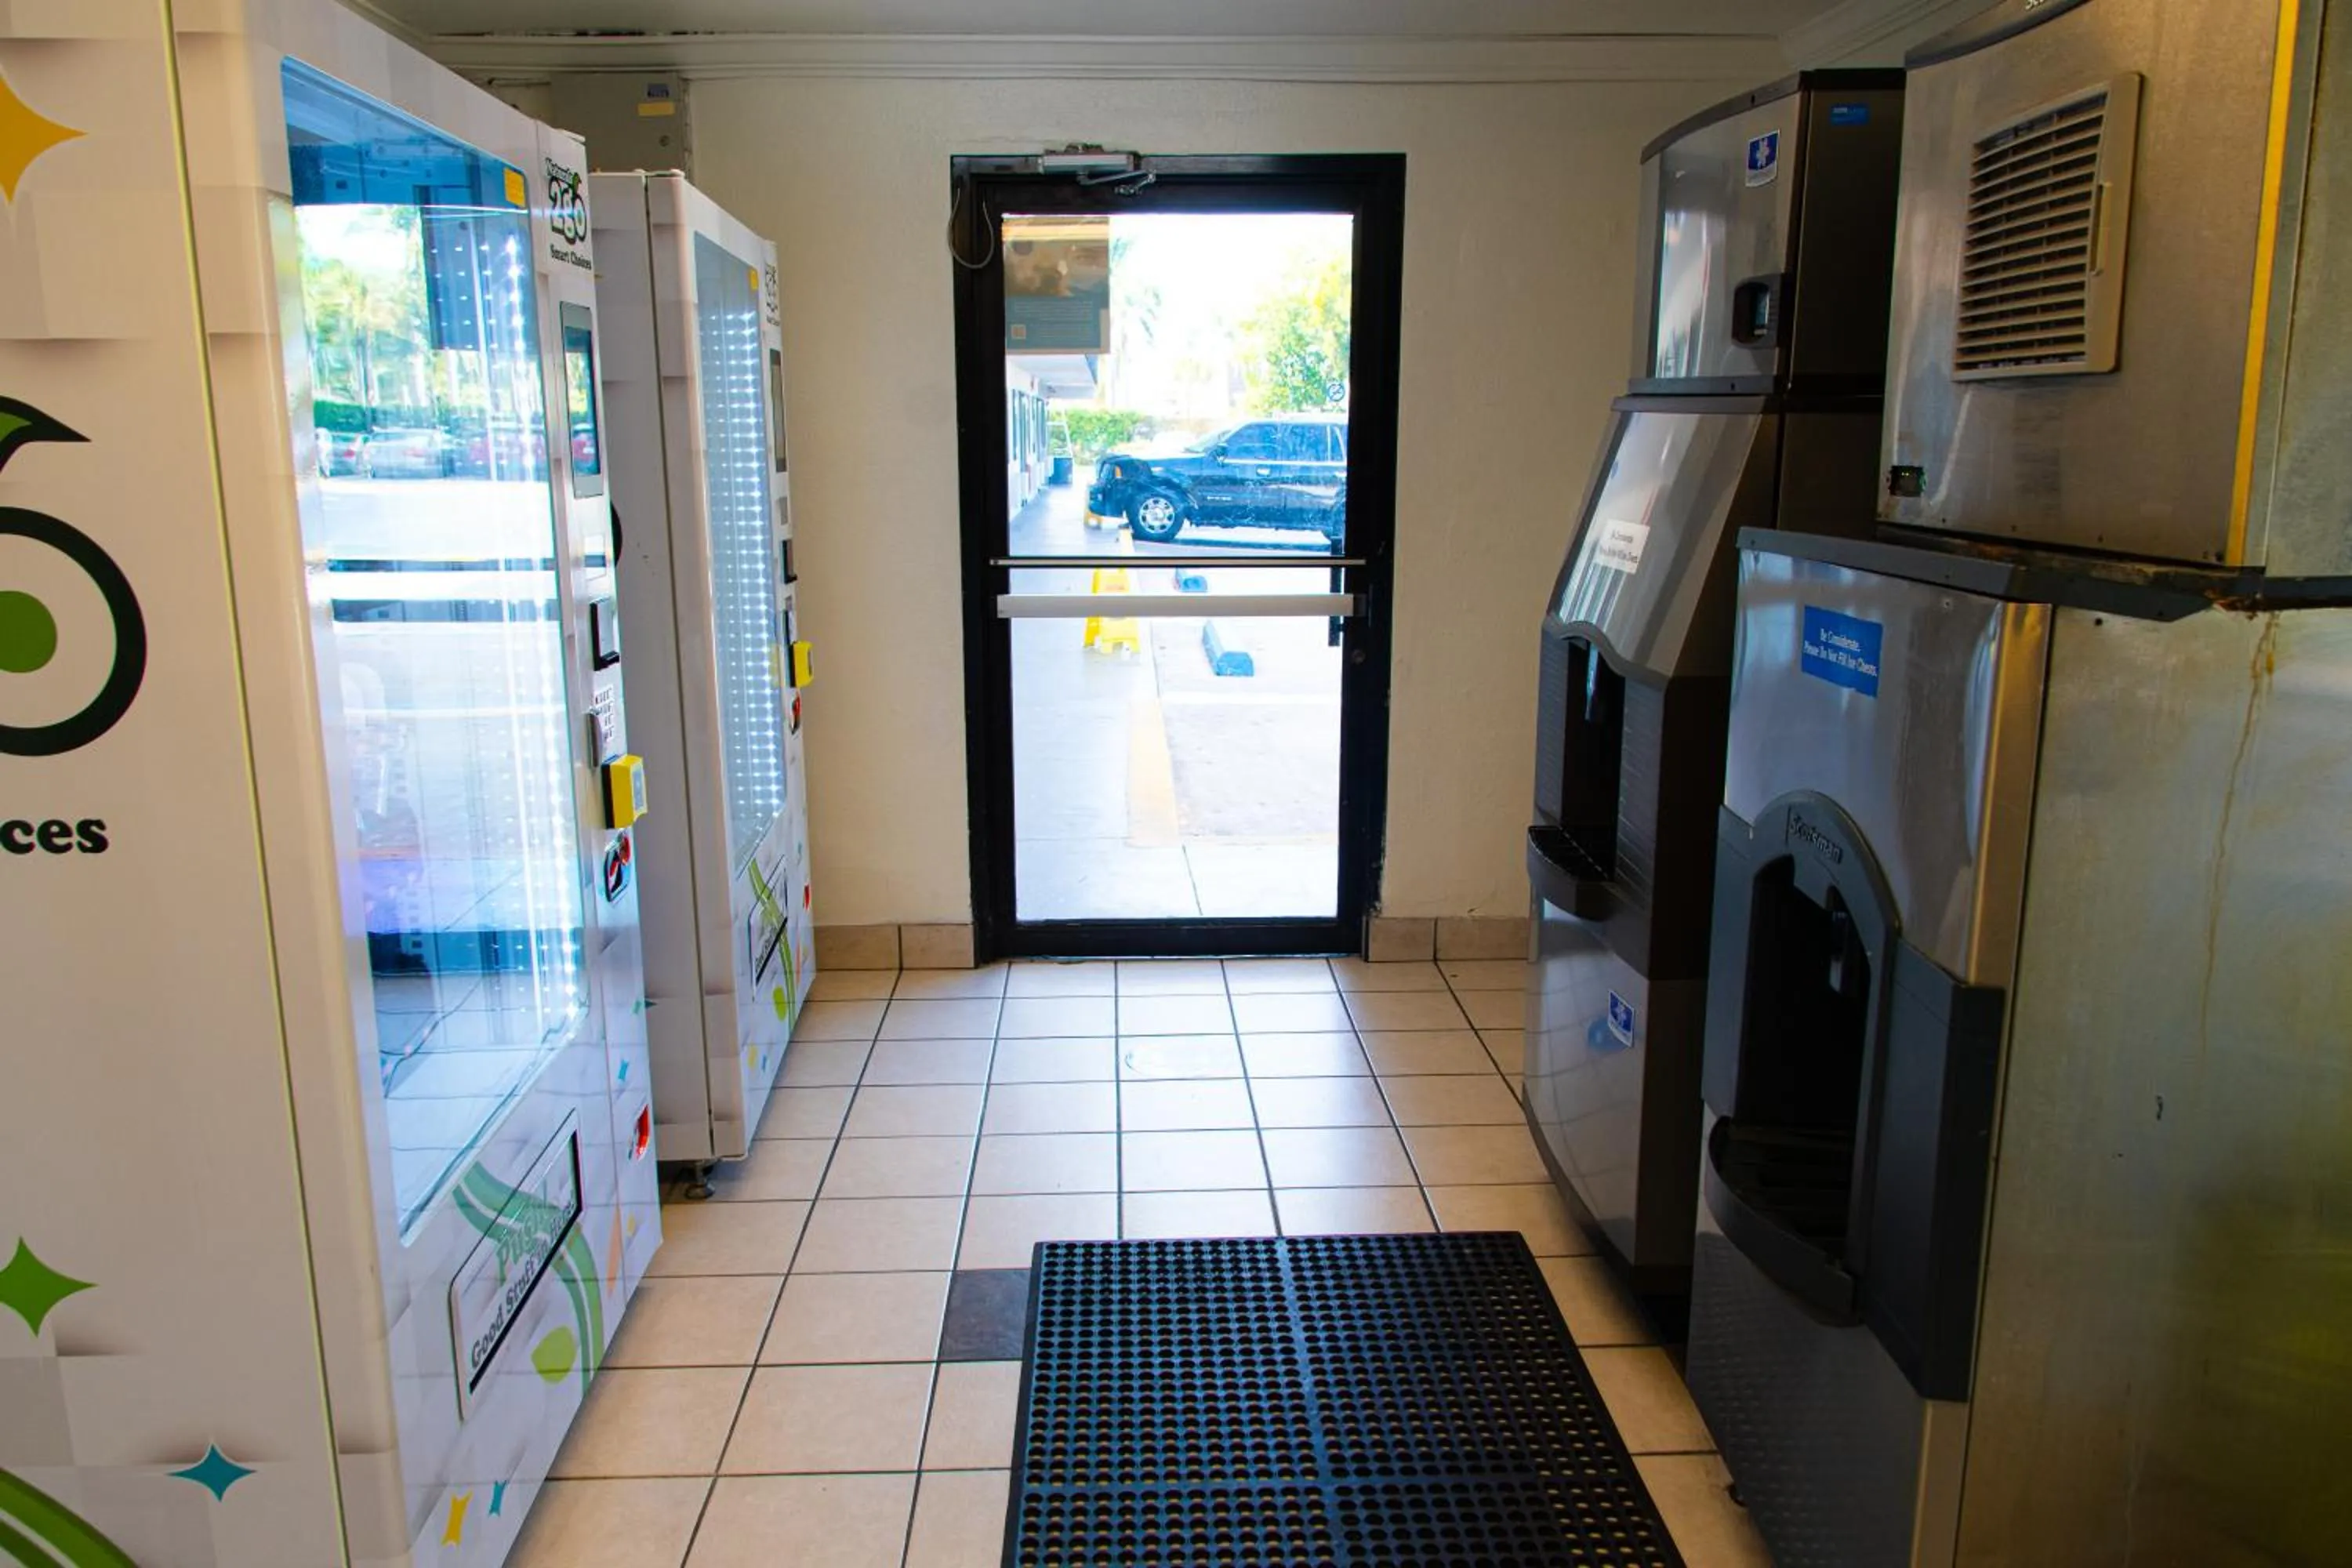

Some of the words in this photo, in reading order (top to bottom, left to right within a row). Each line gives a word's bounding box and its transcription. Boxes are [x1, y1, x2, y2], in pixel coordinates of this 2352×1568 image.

[0, 818, 110, 854] ces
[471, 1303, 505, 1369] Good
[506, 1254, 535, 1315] Stuff
